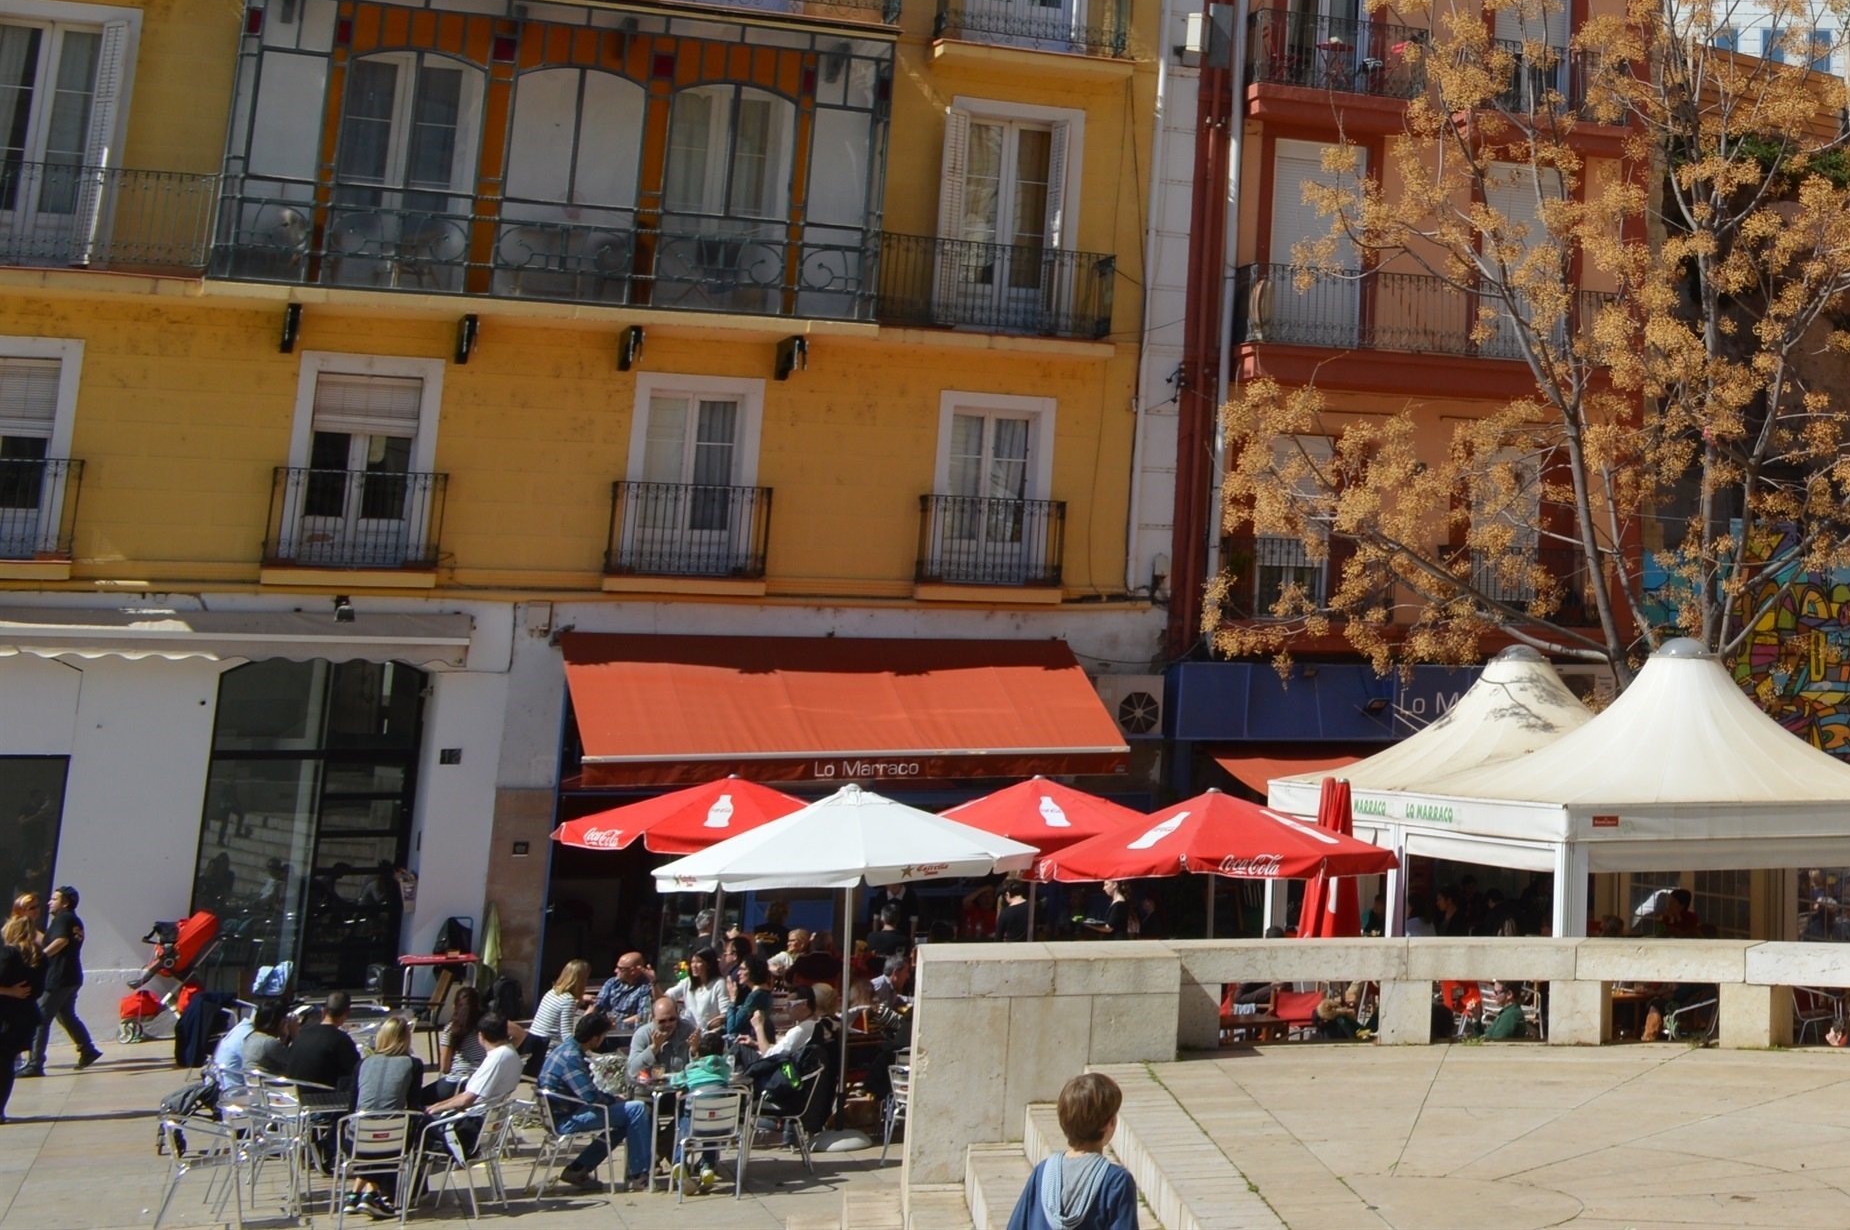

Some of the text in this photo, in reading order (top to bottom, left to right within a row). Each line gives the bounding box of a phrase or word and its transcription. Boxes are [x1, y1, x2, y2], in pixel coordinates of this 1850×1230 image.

[814, 760, 919, 778] Lo Marraco
[1354, 799, 1386, 816] MARRACO
[1405, 802, 1454, 823] LO MARRACO
